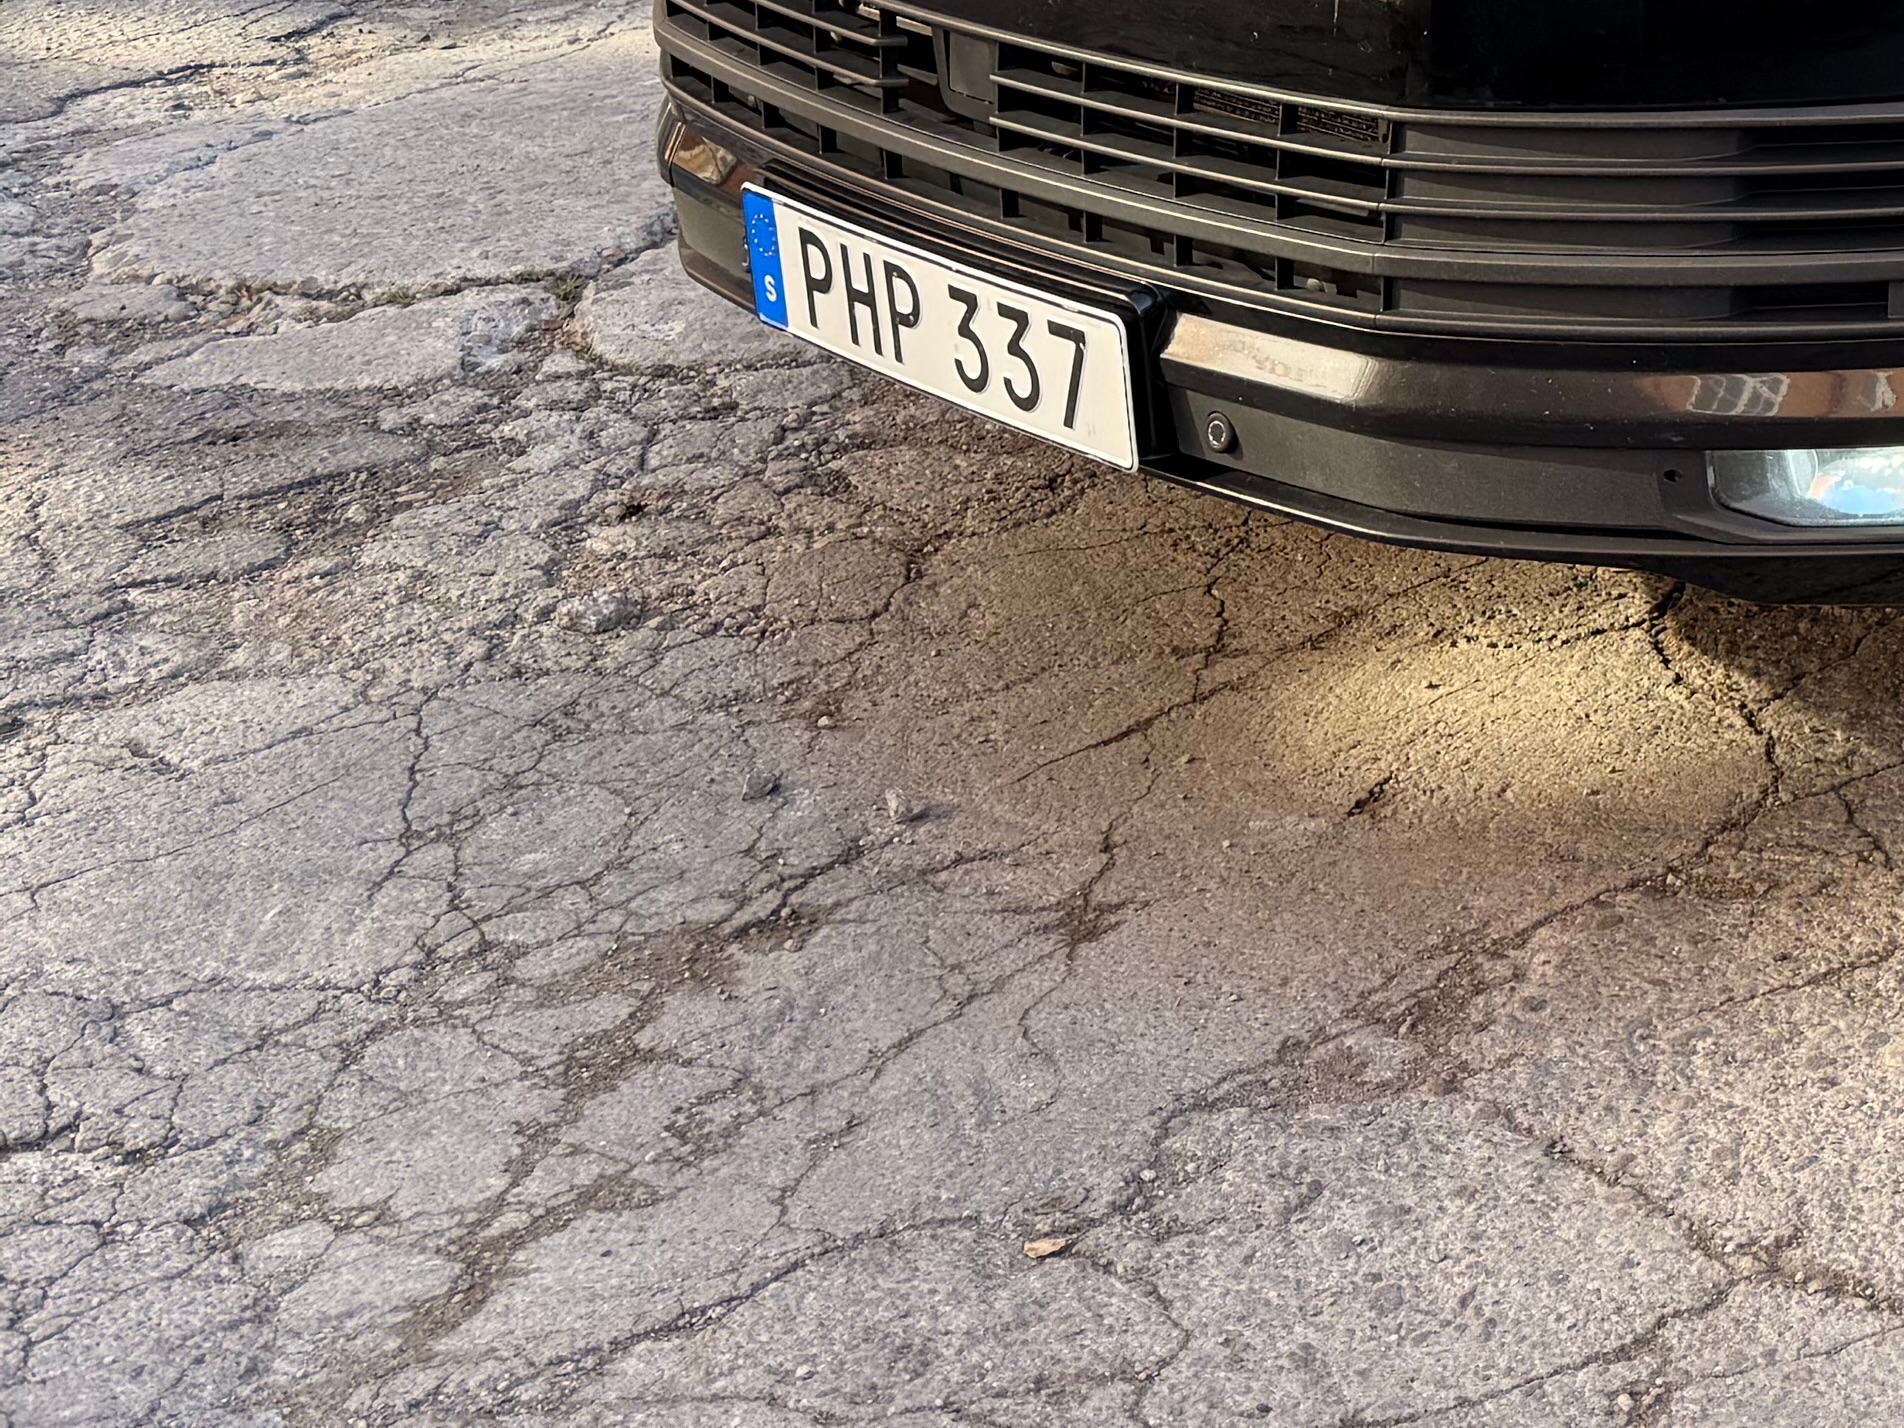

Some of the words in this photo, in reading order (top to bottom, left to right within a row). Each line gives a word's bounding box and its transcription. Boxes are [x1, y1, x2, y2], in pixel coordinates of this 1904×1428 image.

[763, 274, 777, 302] S
[798, 227, 920, 363] PHP
[947, 285, 1086, 430] 337
